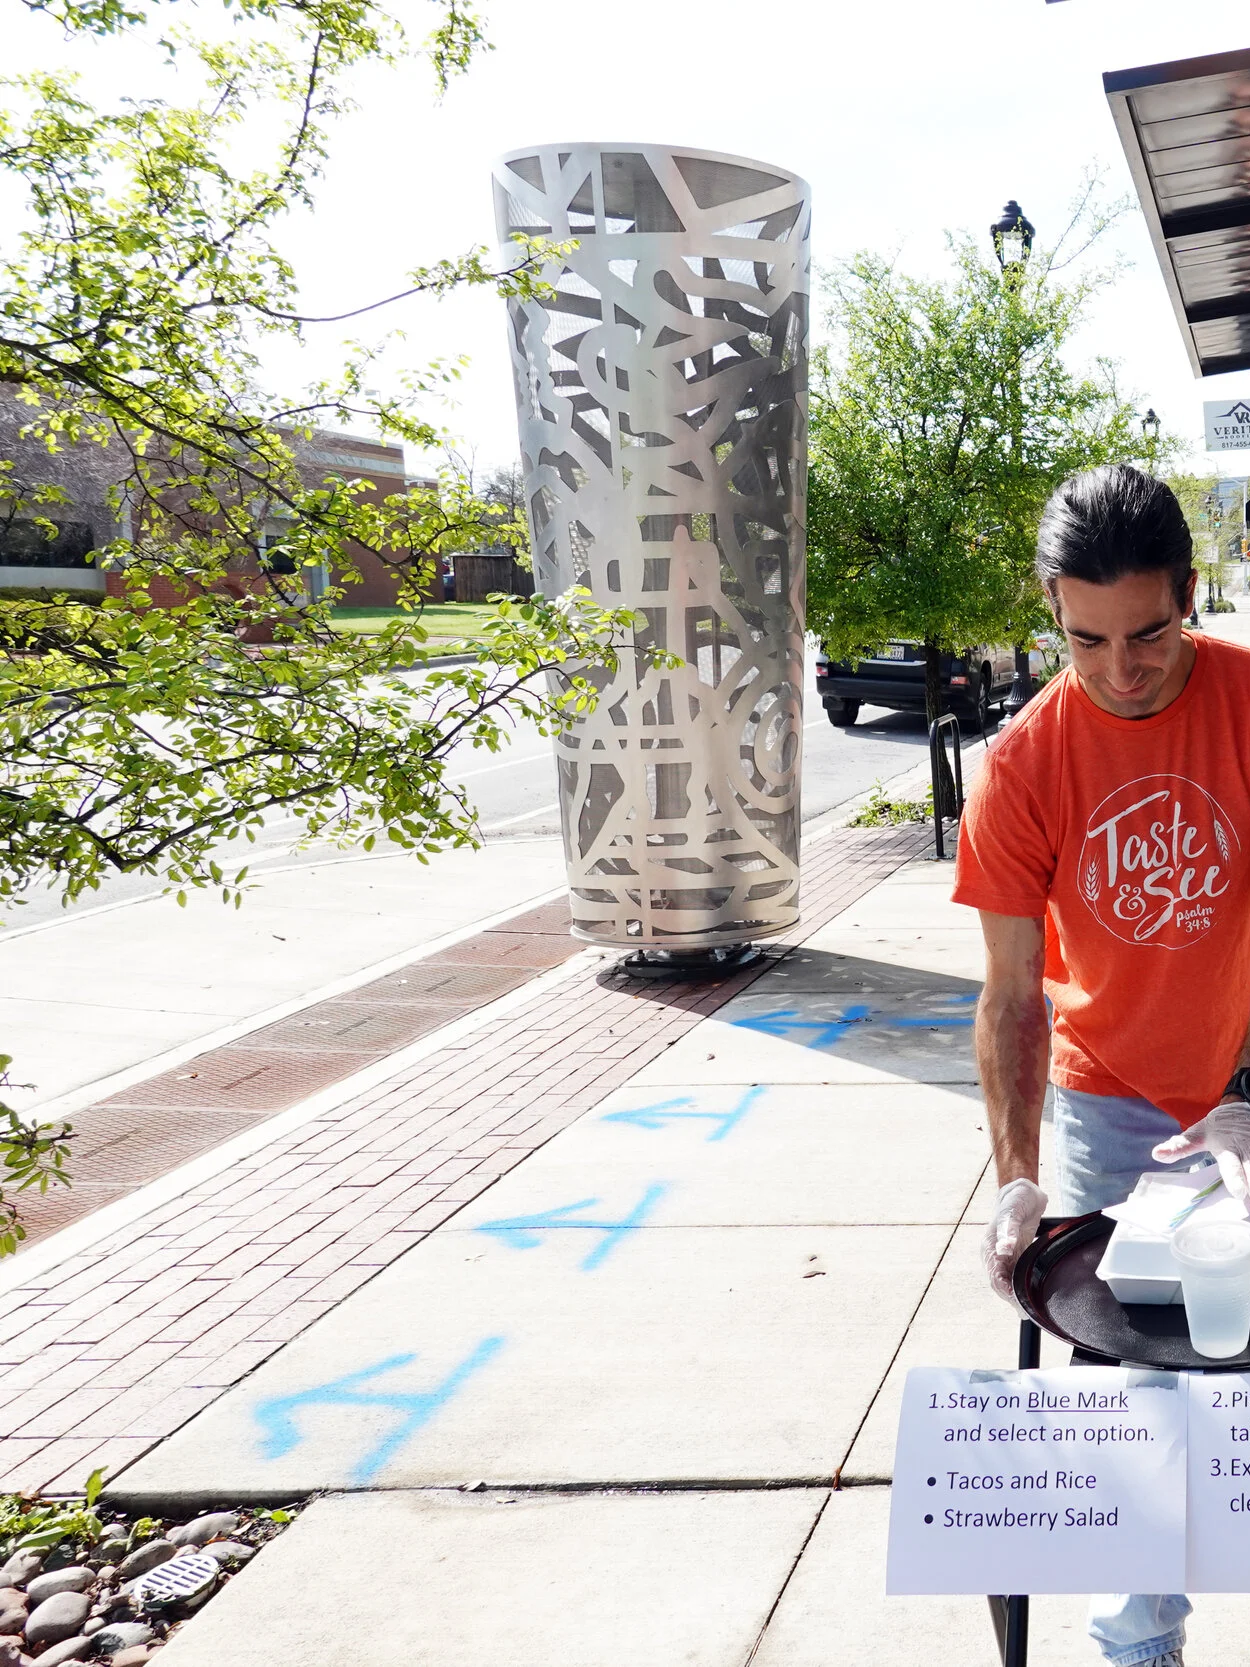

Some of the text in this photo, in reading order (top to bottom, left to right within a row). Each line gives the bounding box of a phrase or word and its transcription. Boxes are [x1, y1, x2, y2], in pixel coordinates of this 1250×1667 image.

[1087, 790, 1208, 888] Taste
[1113, 865, 1231, 941] & See
[1175, 903, 1216, 928] psalm
[1184, 917, 1211, 933] 34:8
[995, 1395, 1020, 1409] on
[1026, 1390, 1070, 1411] Blue
[1076, 1390, 1130, 1411] Mark
[943, 1423, 1156, 1446] and select an option.
[946, 1469, 1097, 1490] Tacos and Rice
[943, 1506, 1119, 1532] Strawberry Salad
